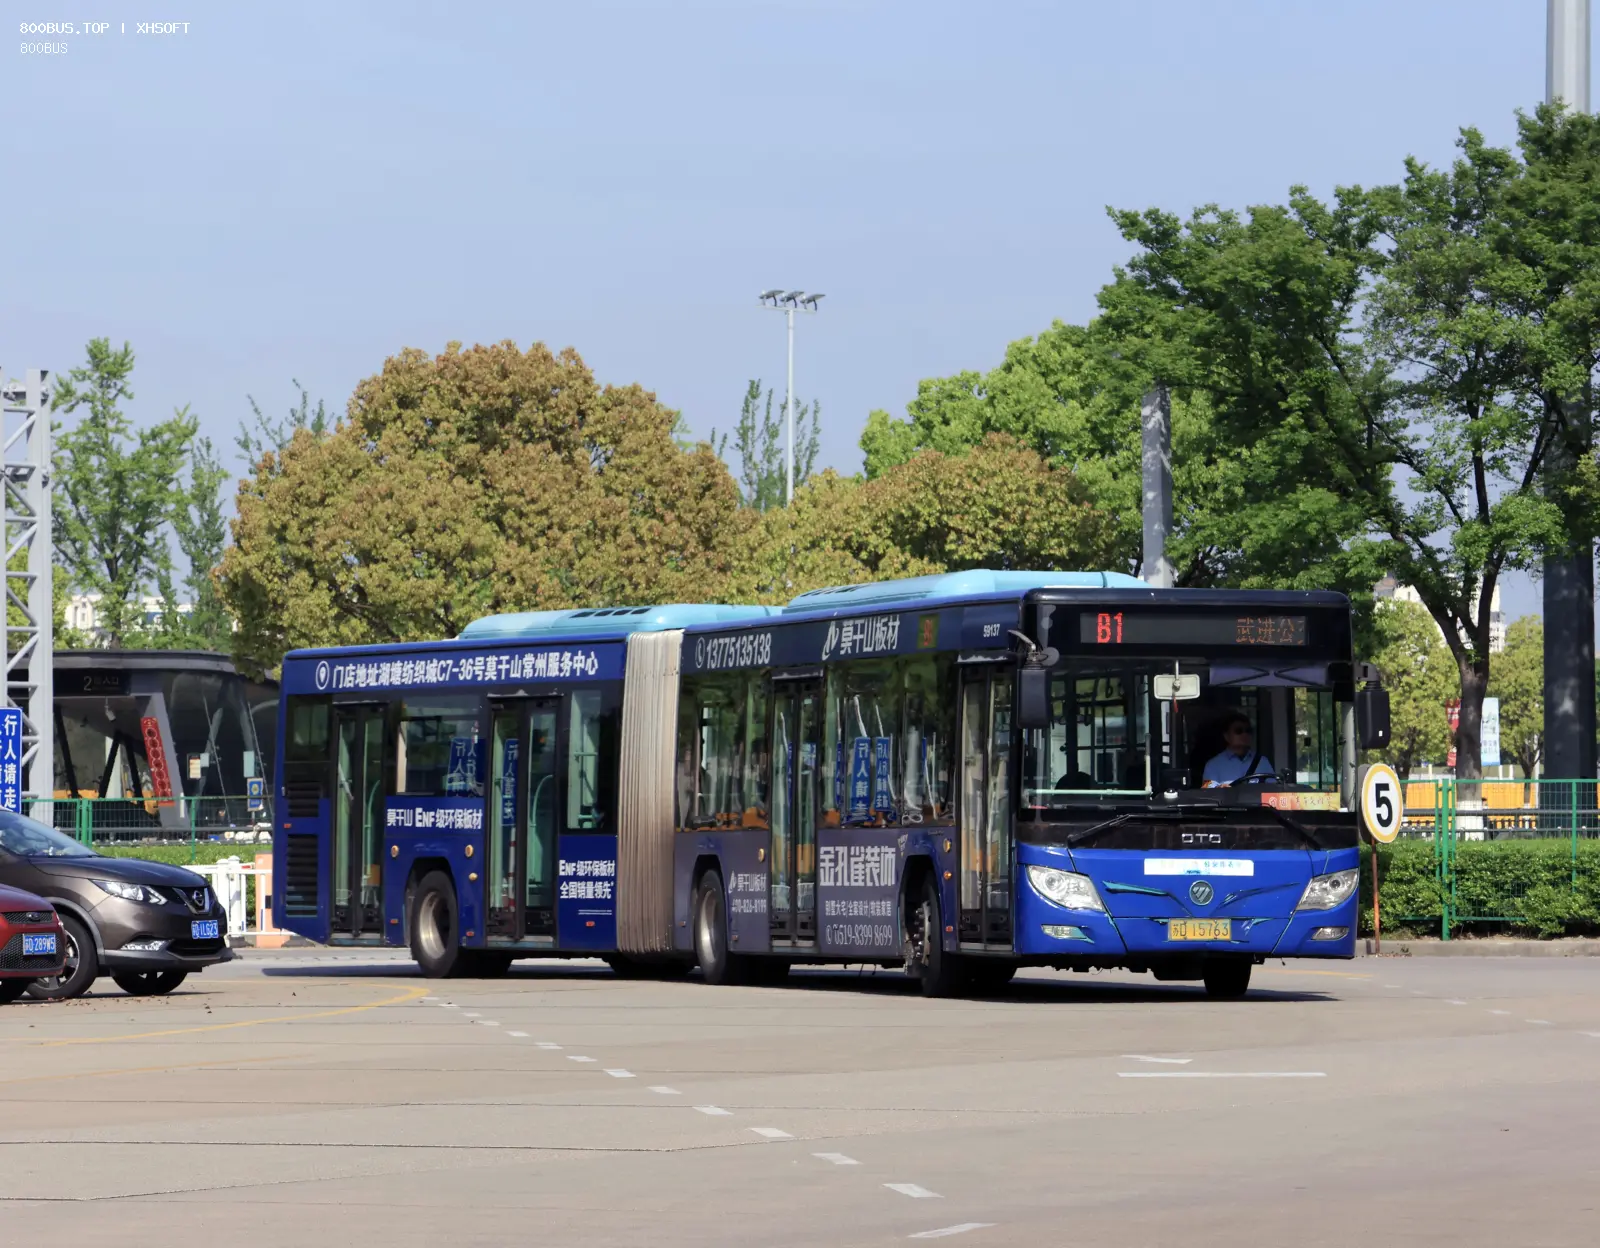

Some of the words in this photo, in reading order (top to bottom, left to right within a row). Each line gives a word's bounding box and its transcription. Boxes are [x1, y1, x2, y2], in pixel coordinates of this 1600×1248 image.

[840, 614, 900, 655] 莫干山板材
[982, 623, 1001, 638] 59137
[1096, 613, 1124, 644] B1
[706, 633, 772, 669] 13775135138
[1374, 783, 1393, 828] 5
[737, 874, 767, 892] 莫干山板材
[819, 846, 897, 887] 金孔雀装饰
